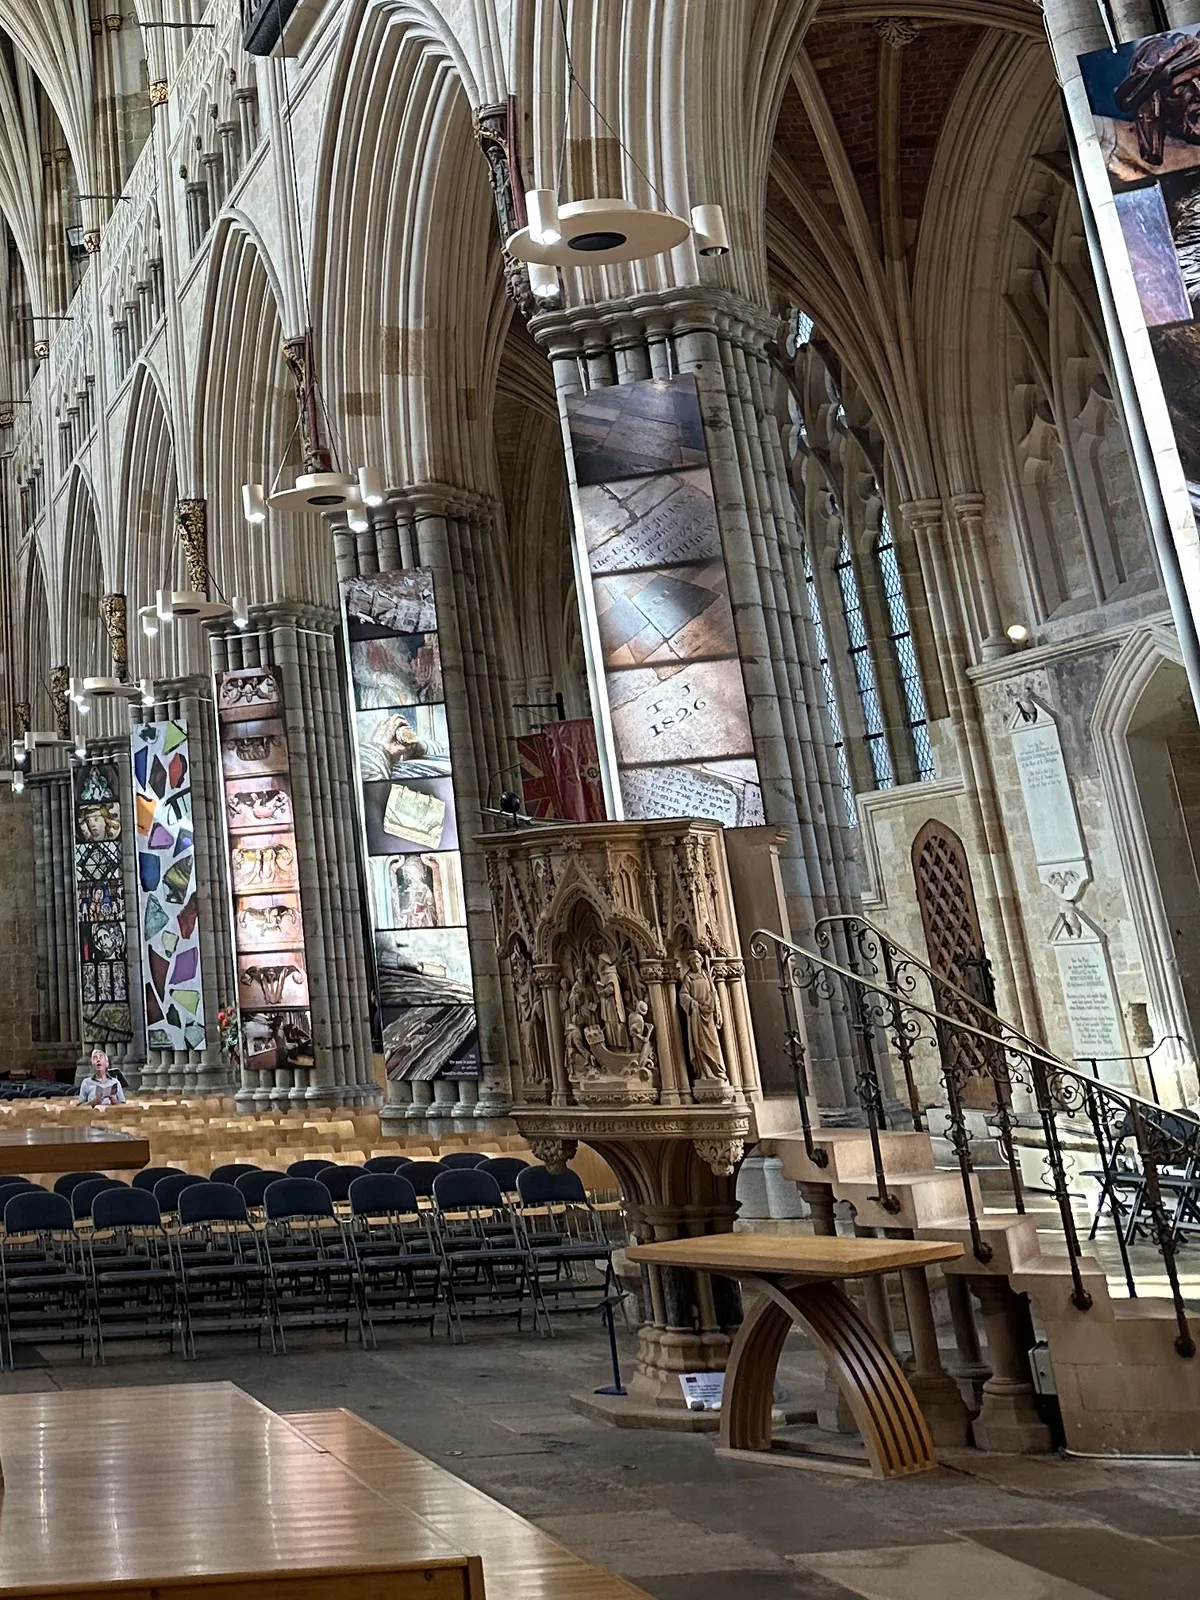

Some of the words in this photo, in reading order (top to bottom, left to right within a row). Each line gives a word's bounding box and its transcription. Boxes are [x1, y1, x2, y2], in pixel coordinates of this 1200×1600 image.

[611, 534, 638, 555] Body
[629, 520, 677, 556] Daughter
[646, 699, 662, 714] T
[681, 683, 691, 696] J
[650, 699, 706, 737] 1826
[709, 802, 730, 812] DAY
